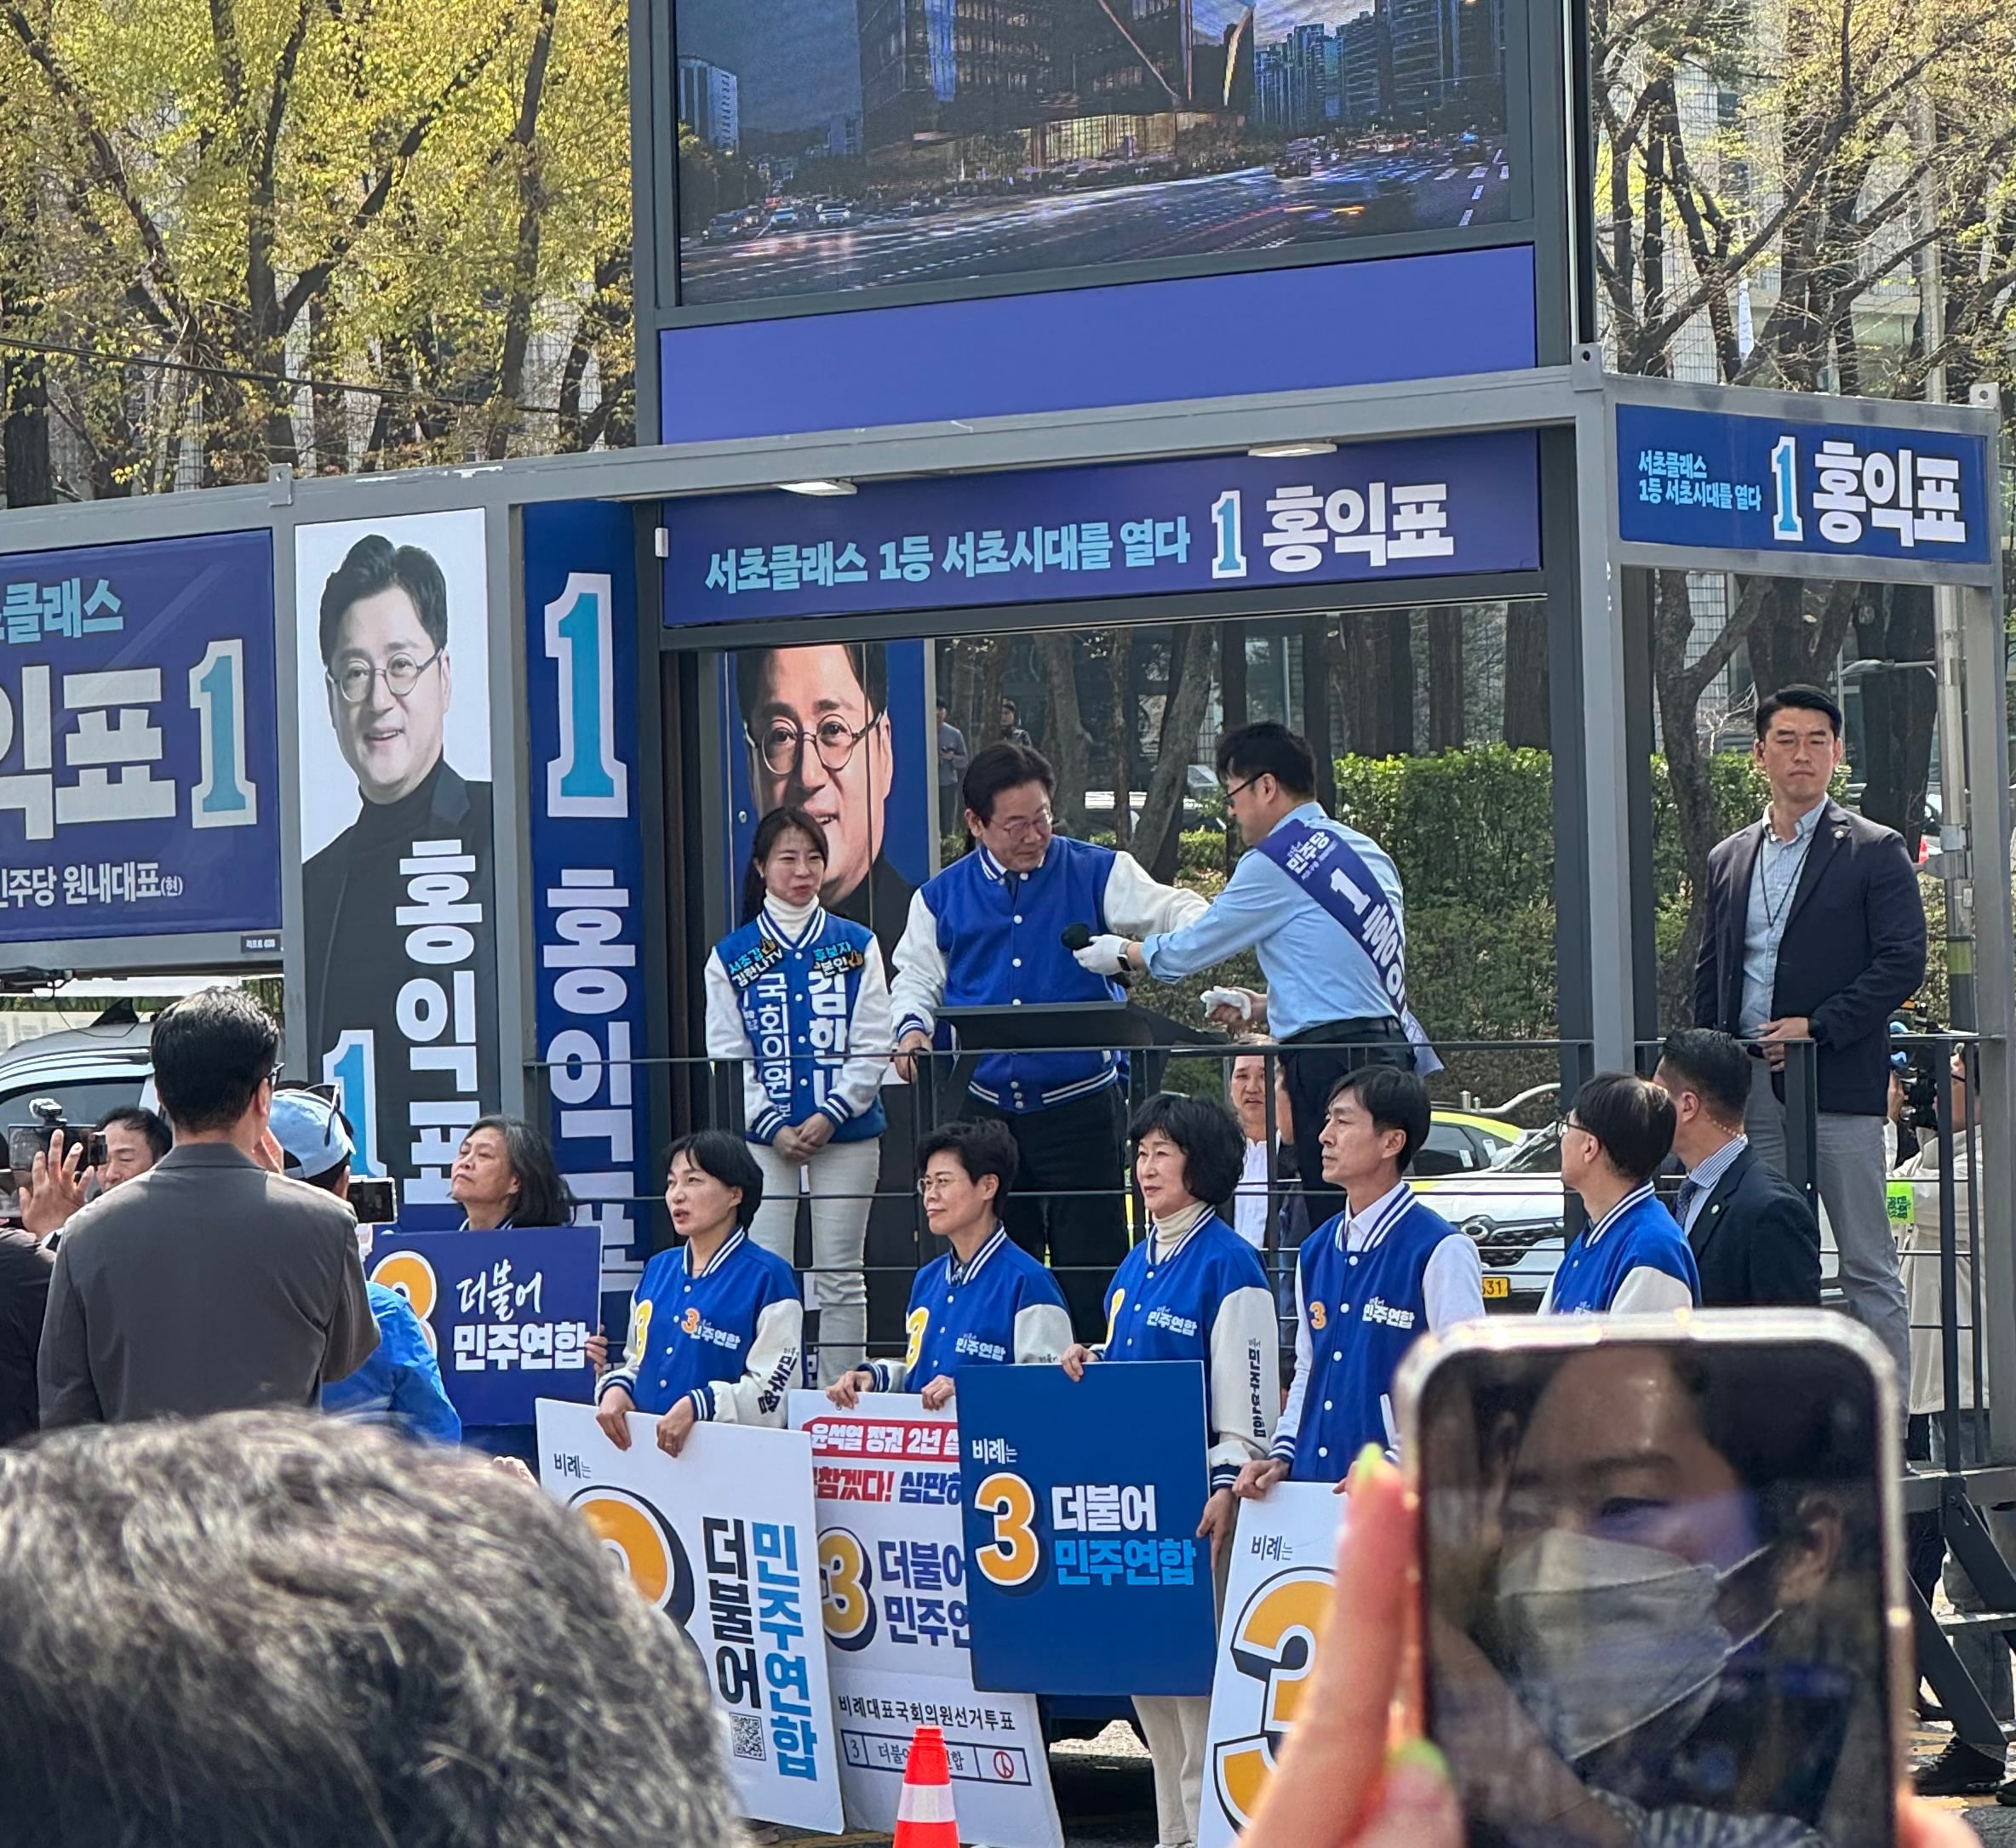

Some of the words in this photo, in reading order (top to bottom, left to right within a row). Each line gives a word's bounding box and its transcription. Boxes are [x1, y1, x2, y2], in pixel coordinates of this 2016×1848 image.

[1639, 449, 1708, 478] 서초클래스
[1639, 479, 1663, 505] 1등
[1665, 481, 1733, 510] 서초시대를
[1734, 484, 1762, 512] 열다
[1771, 435, 1804, 541] 1
[1813, 440, 1967, 547] 홍익표
[705, 540, 868, 594] 서초클래스
[879, 535, 933, 582] 1등
[941, 521, 1114, 577] 서초시대를
[1120, 516, 1190, 568] 열다
[1211, 489, 1248, 579] 1
[1262, 482, 1454, 573] 홍익표
[0, 577, 123, 644] 클래스
[544, 572, 628, 818] 1
[189, 638, 257, 829] 1
[1330, 867, 1372, 917] 1
[396, 838, 483, 1205] 홍익표
[756, 972, 793, 1100] 국회의원
[455, 1258, 543, 1322] 더불어
[1309, 1301, 1327, 1330] 3
[453, 1320, 591, 1372] 민주연합
[680, 1307, 701, 1335] 3
[810, 1422, 864, 1452] 윤석열
[866, 1425, 905, 1454] 정권
[906, 1427, 942, 1456] 2년
[971, 1437, 1018, 1465] 비례는
[553, 1452, 592, 1479] 비례는
[813, 1466, 895, 1503] 참겠다!
[974, 1472, 1039, 1586] 3
[1051, 1484, 1158, 1533] 더불어
[1054, 1537, 1197, 1587] 민주연합
[1251, 1534, 1294, 1562] 비례는
[702, 1516, 762, 1710] 더불어
[817, 1526, 873, 1648] 3
[750, 1520, 818, 1782] 민주연합
